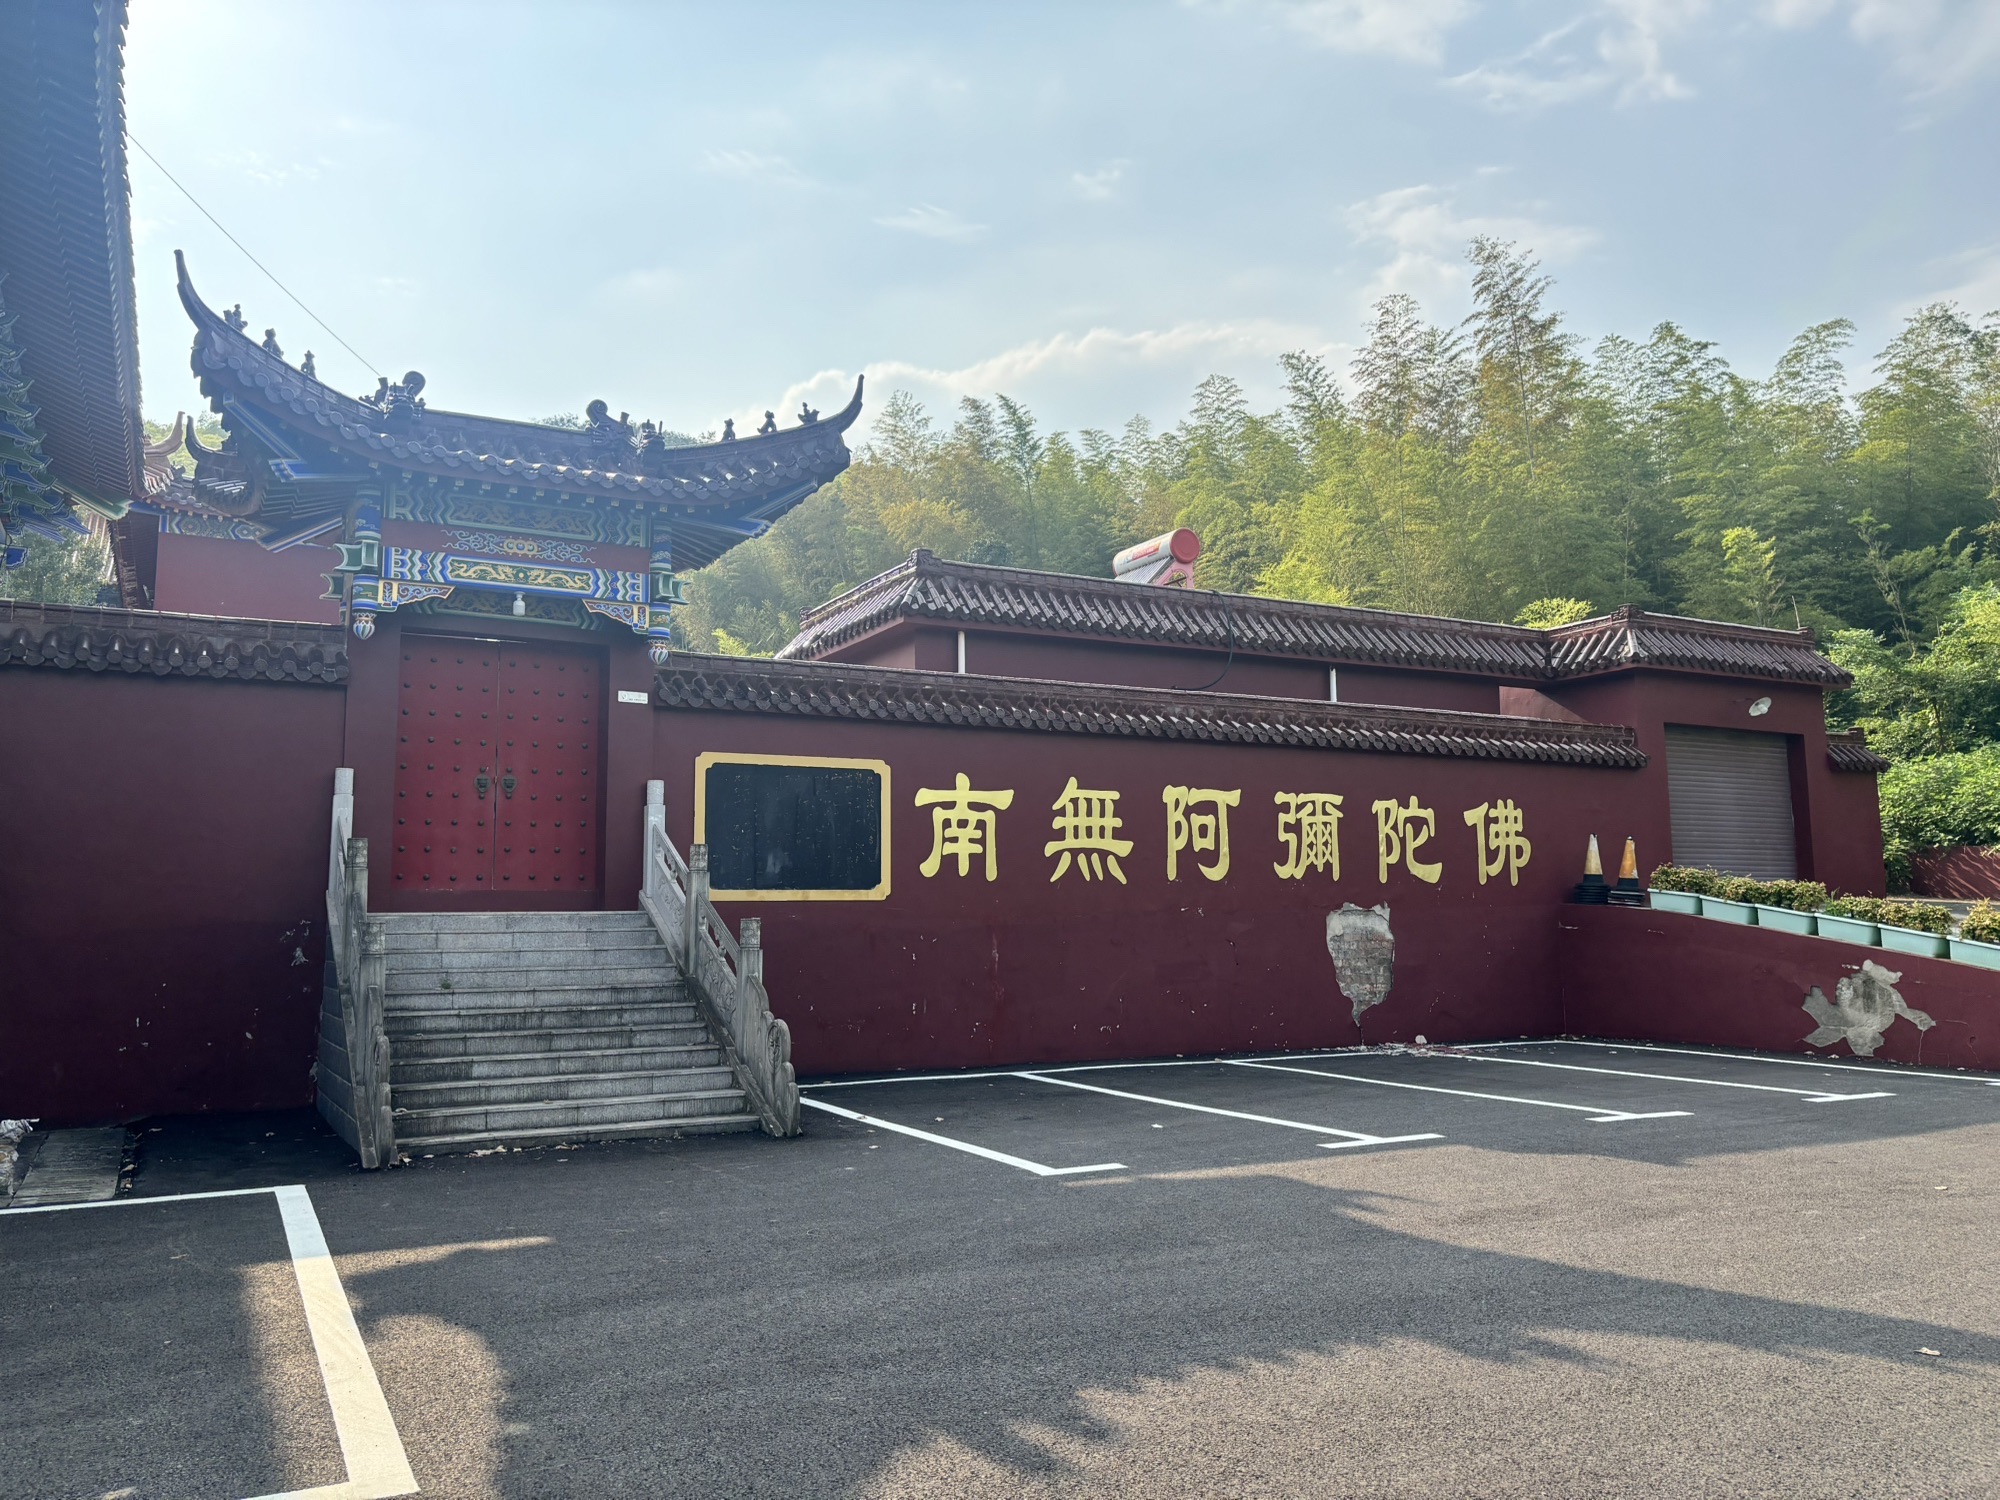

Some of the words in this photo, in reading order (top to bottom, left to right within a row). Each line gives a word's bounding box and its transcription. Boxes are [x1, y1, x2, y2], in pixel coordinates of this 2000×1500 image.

[914, 772, 1532, 887] 南無阿彌陀佛
